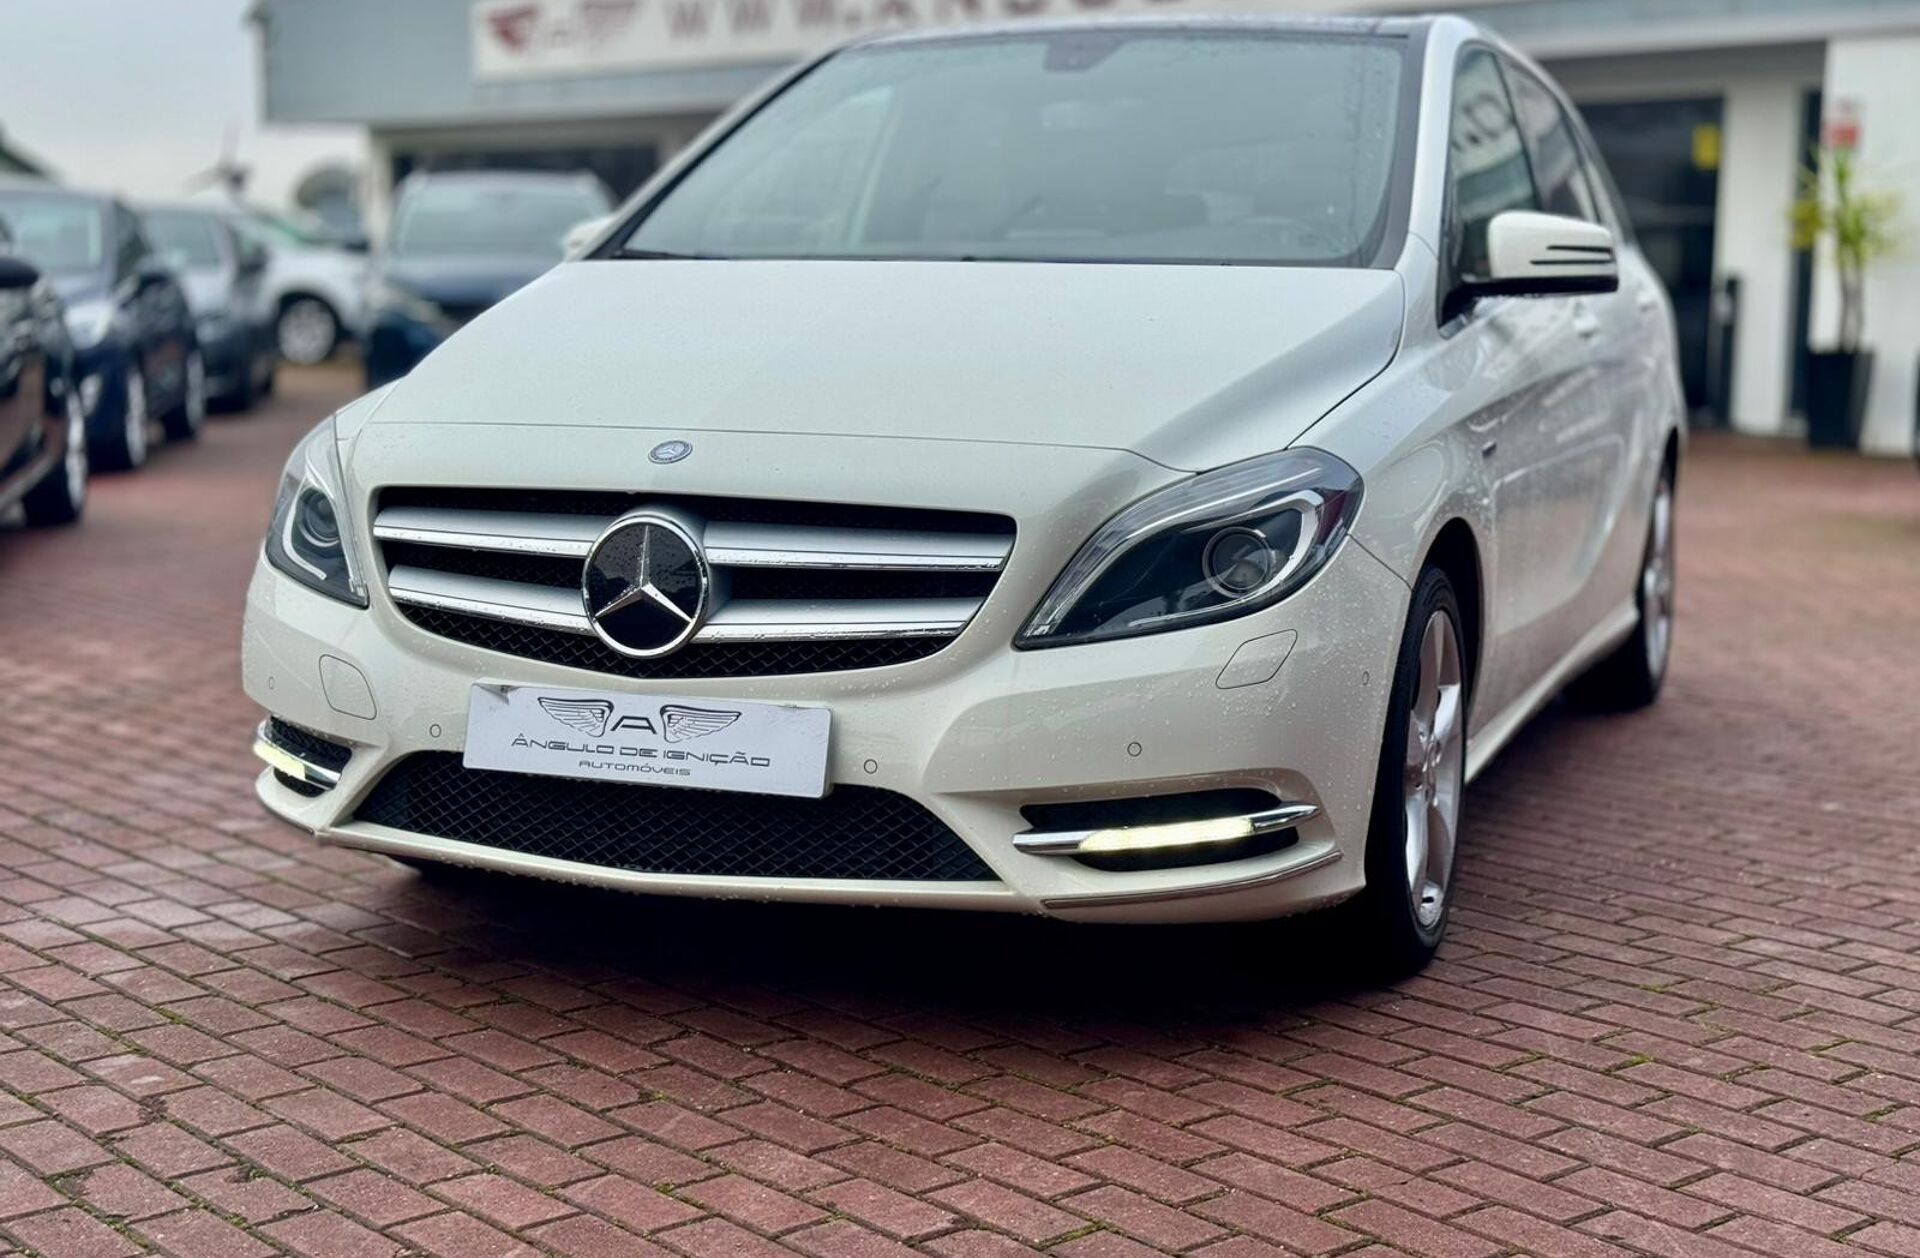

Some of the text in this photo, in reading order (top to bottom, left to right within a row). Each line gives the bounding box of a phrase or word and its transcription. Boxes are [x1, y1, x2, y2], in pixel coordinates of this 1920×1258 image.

[610, 715, 657, 735] A
[511, 733, 771, 767] ÂNGULO DE IGNIÇÃO
[578, 760, 691, 776] AUTOMÓVEIS
